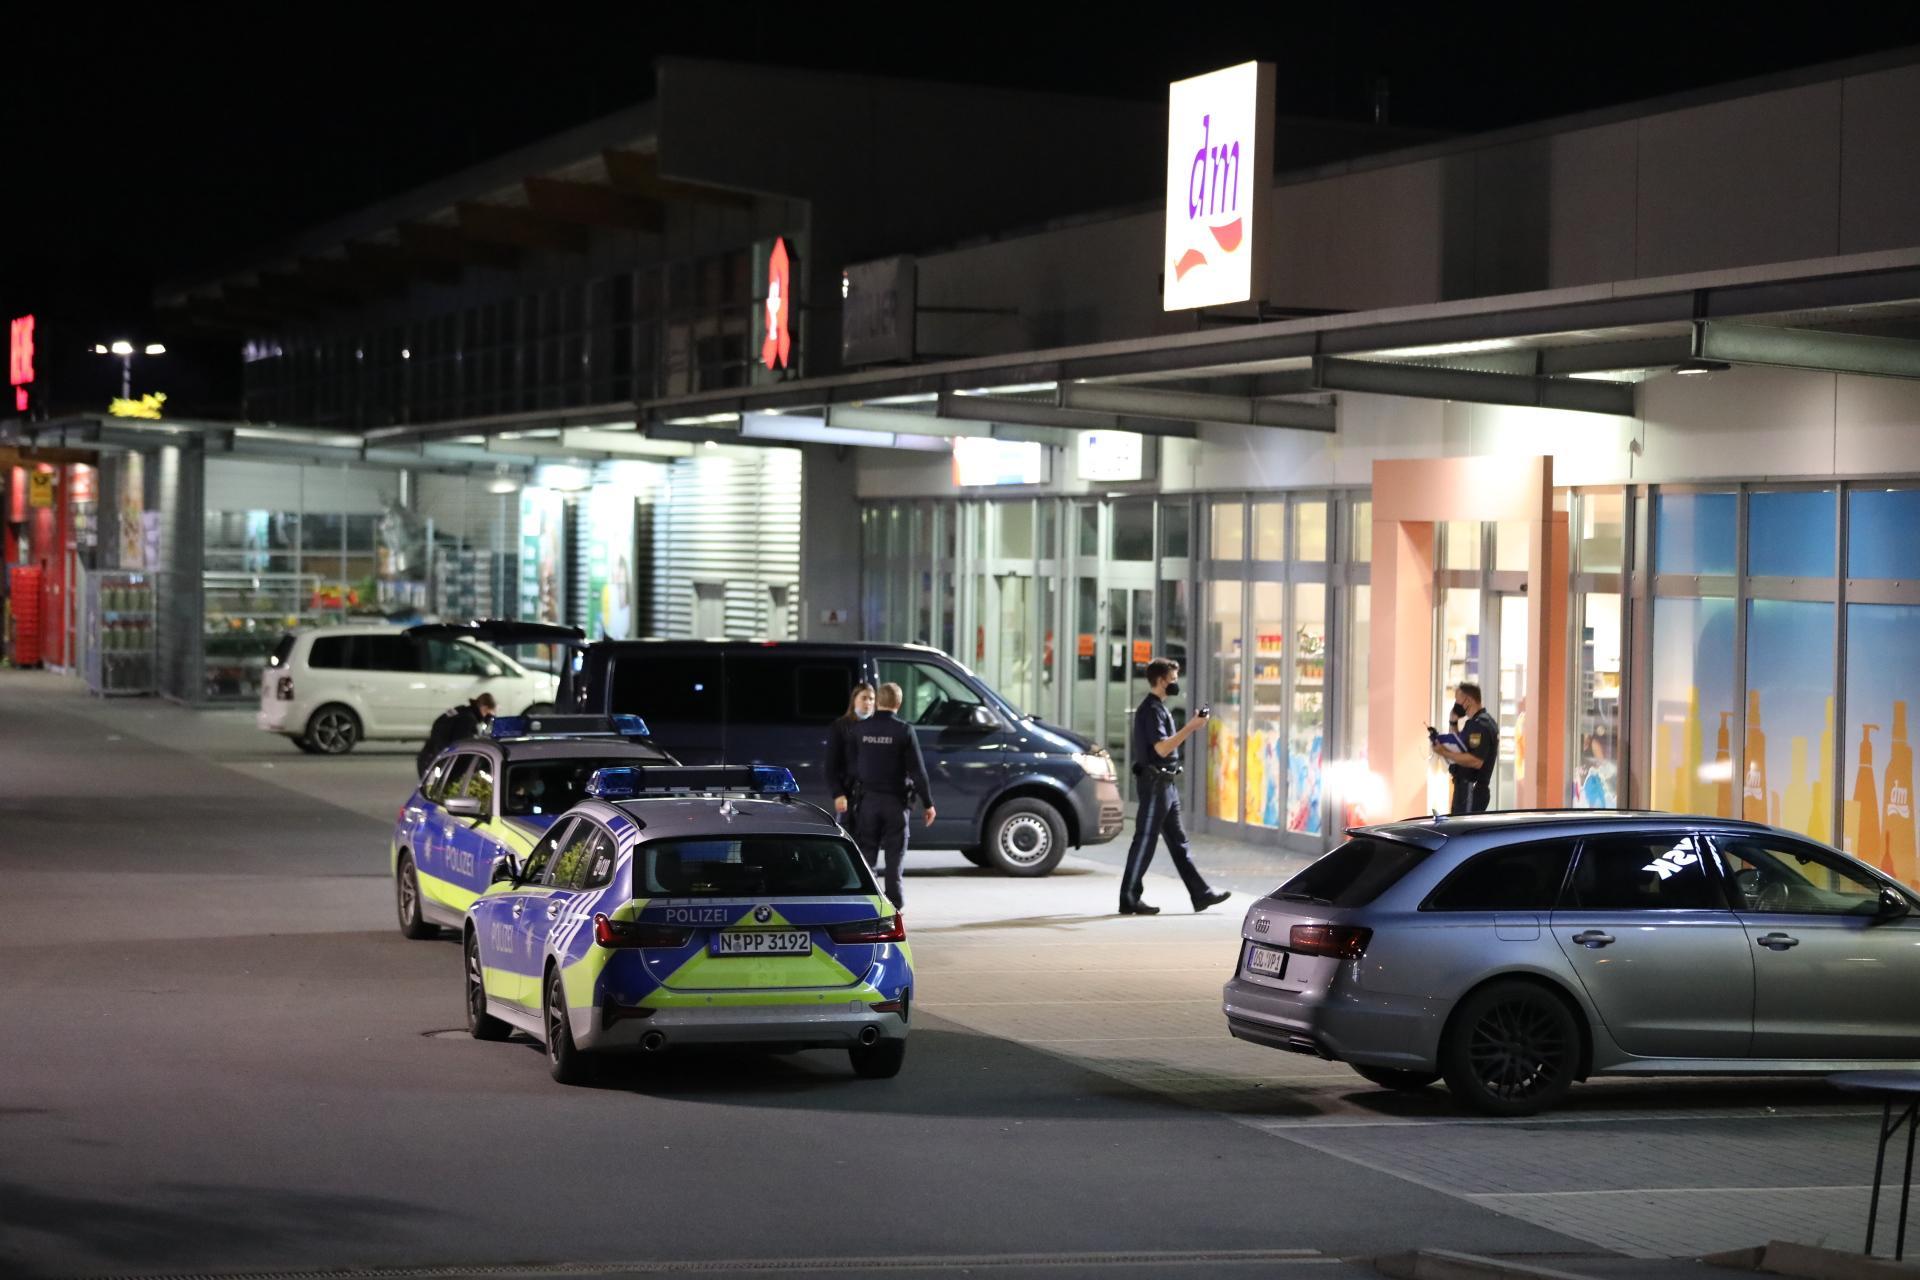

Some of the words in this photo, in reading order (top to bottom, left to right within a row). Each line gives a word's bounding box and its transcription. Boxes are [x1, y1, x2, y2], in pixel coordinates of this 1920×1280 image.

[1188, 113, 1240, 220] dm
[862, 735, 893, 744] POLIZEI
[1890, 779, 1908, 806] dm
[445, 845, 474, 877] POLIZEI
[666, 908, 728, 922] POLIZEI
[490, 922, 514, 954] POLIZEI
[720, 934, 732, 950] N
[743, 934, 764, 950] PP
[768, 933, 808, 950] 3192
